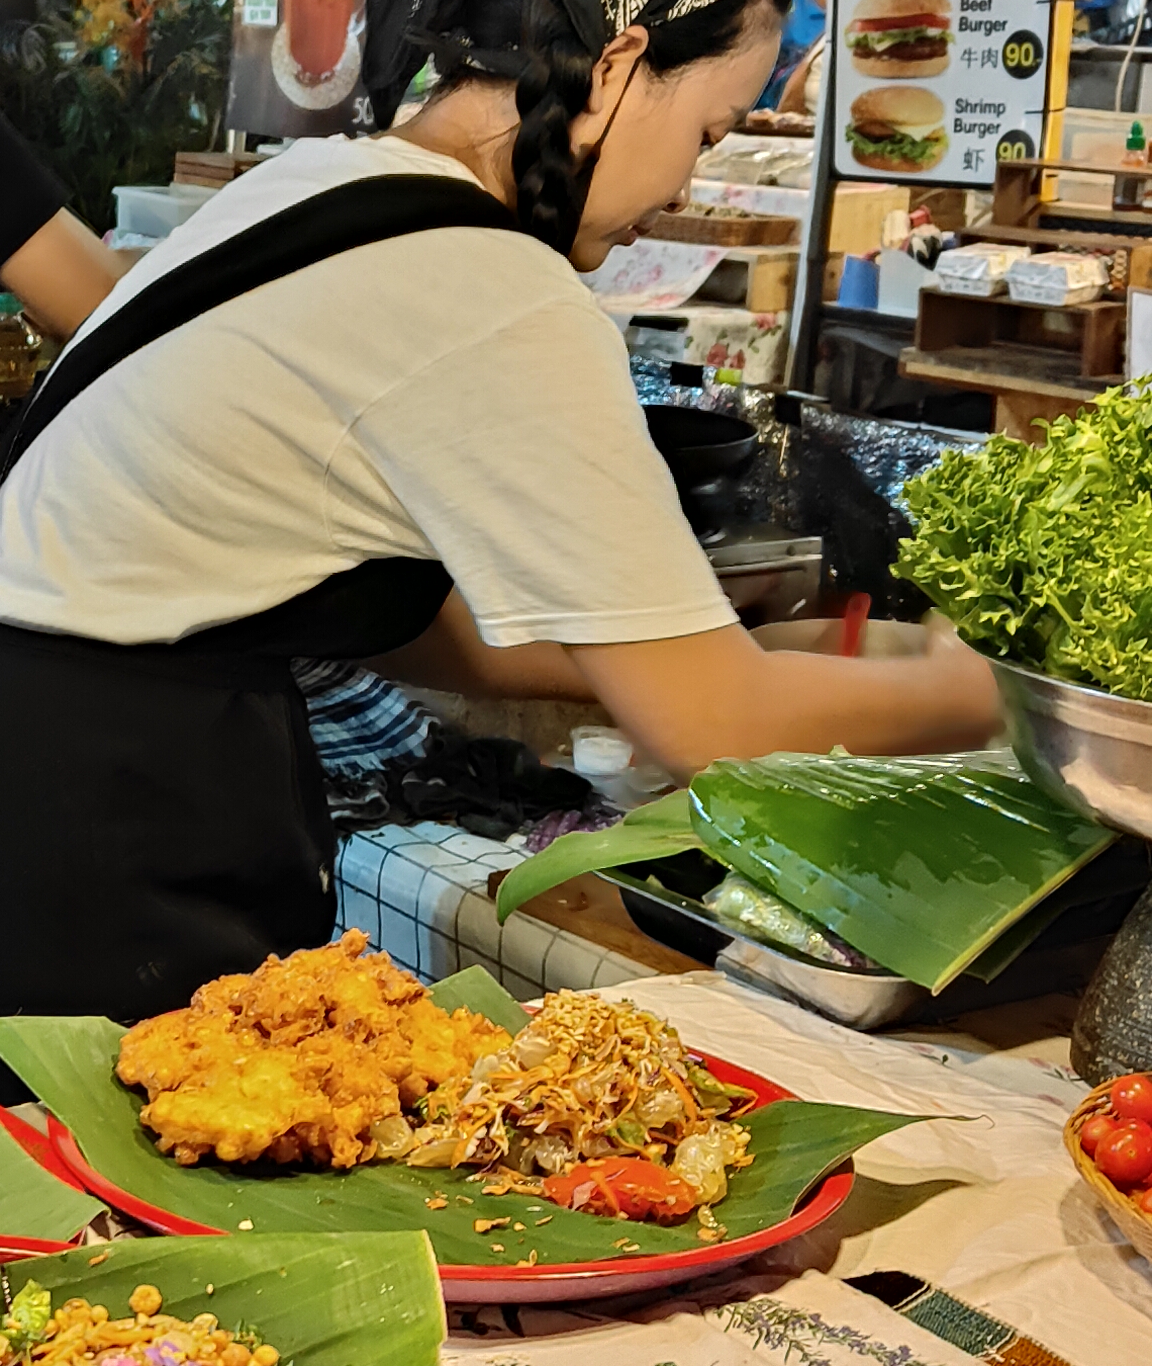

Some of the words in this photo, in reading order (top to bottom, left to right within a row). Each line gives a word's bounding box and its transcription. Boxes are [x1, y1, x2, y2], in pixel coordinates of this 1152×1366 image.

[958, 16, 1008, 36] Burger
[959, 47, 999, 70] 牛肉
[955, 98, 1007, 120] Shrimp
[953, 118, 1002, 138] Burger
